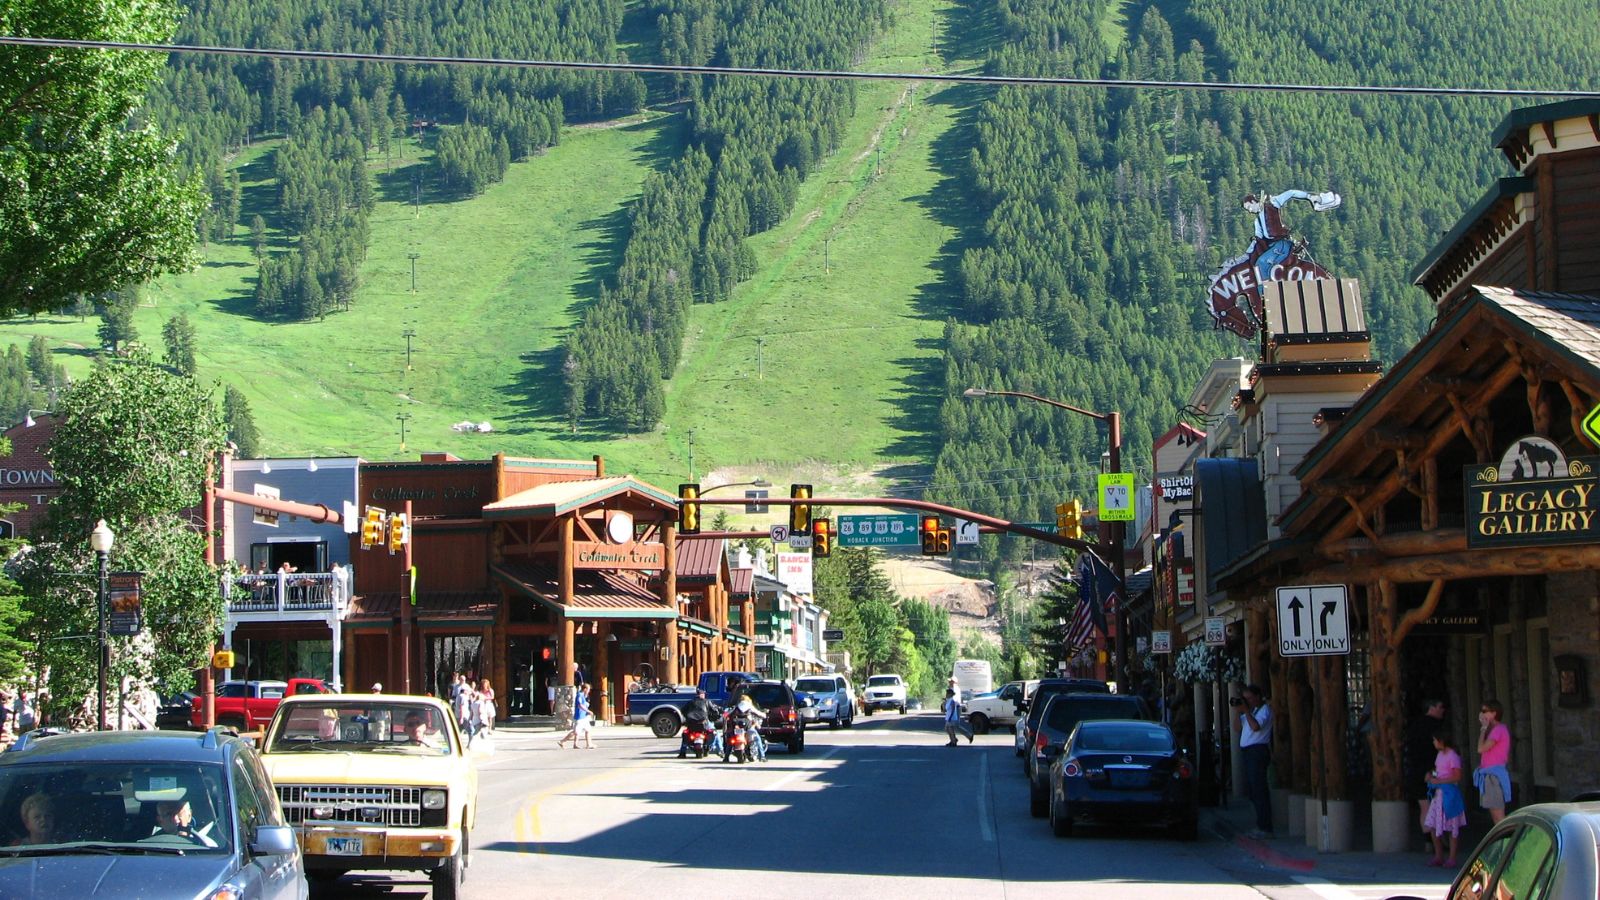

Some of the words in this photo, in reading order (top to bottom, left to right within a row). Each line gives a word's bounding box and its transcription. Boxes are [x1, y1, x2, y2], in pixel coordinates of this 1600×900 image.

[1479, 483, 1596, 514] LEGACY
[843, 524, 852, 532] 26
[861, 524, 870, 532] 89
[1479, 510, 1597, 536] GALLERY
[1283, 640, 1311, 651] ONLY
[1315, 638, 1346, 650] ONLY
